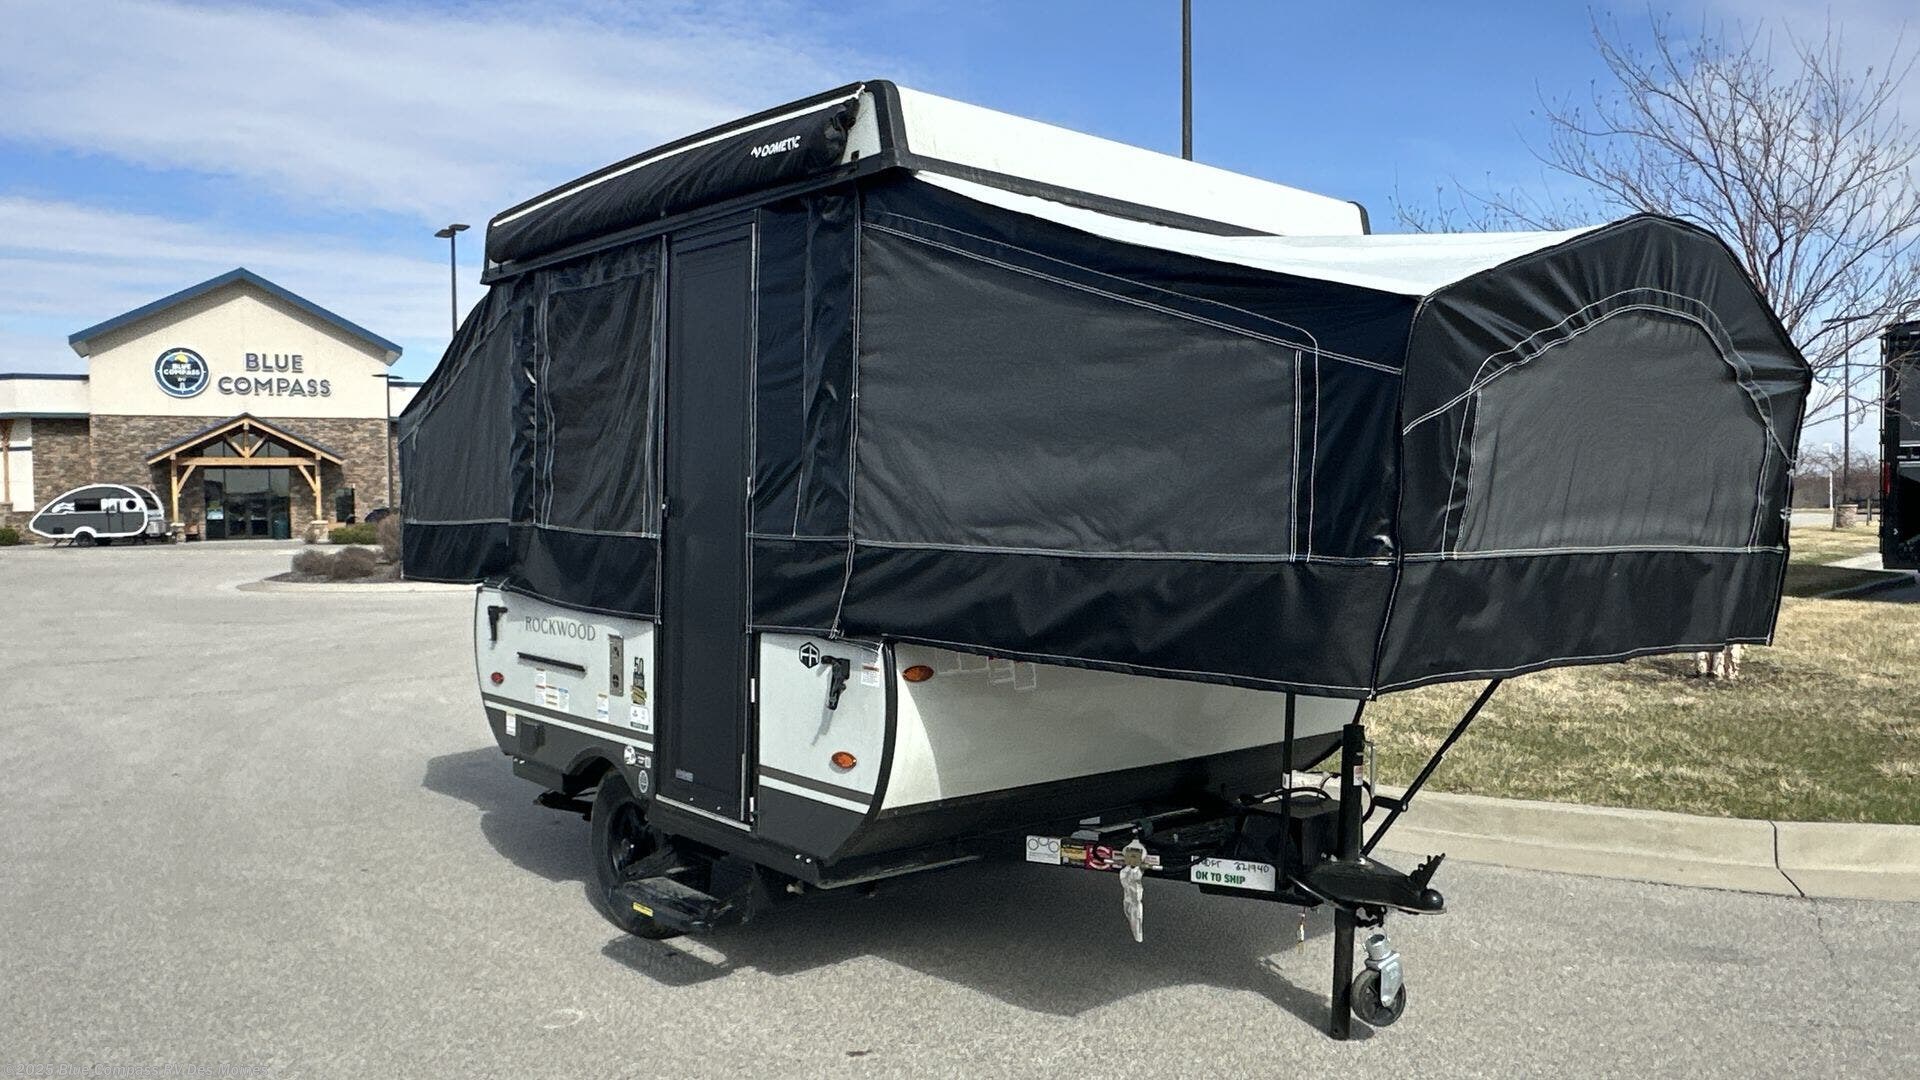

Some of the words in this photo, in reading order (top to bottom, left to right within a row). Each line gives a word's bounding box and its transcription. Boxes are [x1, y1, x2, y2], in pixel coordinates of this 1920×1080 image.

[761, 135, 801, 157] DOMETIC
[245, 353, 304, 373] BLUE
[217, 377, 332, 397] COMPASS
[525, 616, 596, 641] ROCKWOOD
[1195, 870, 1209, 880] OK
[1210, 872, 1222, 884] TO
[1224, 873, 1246, 885] SHIP
